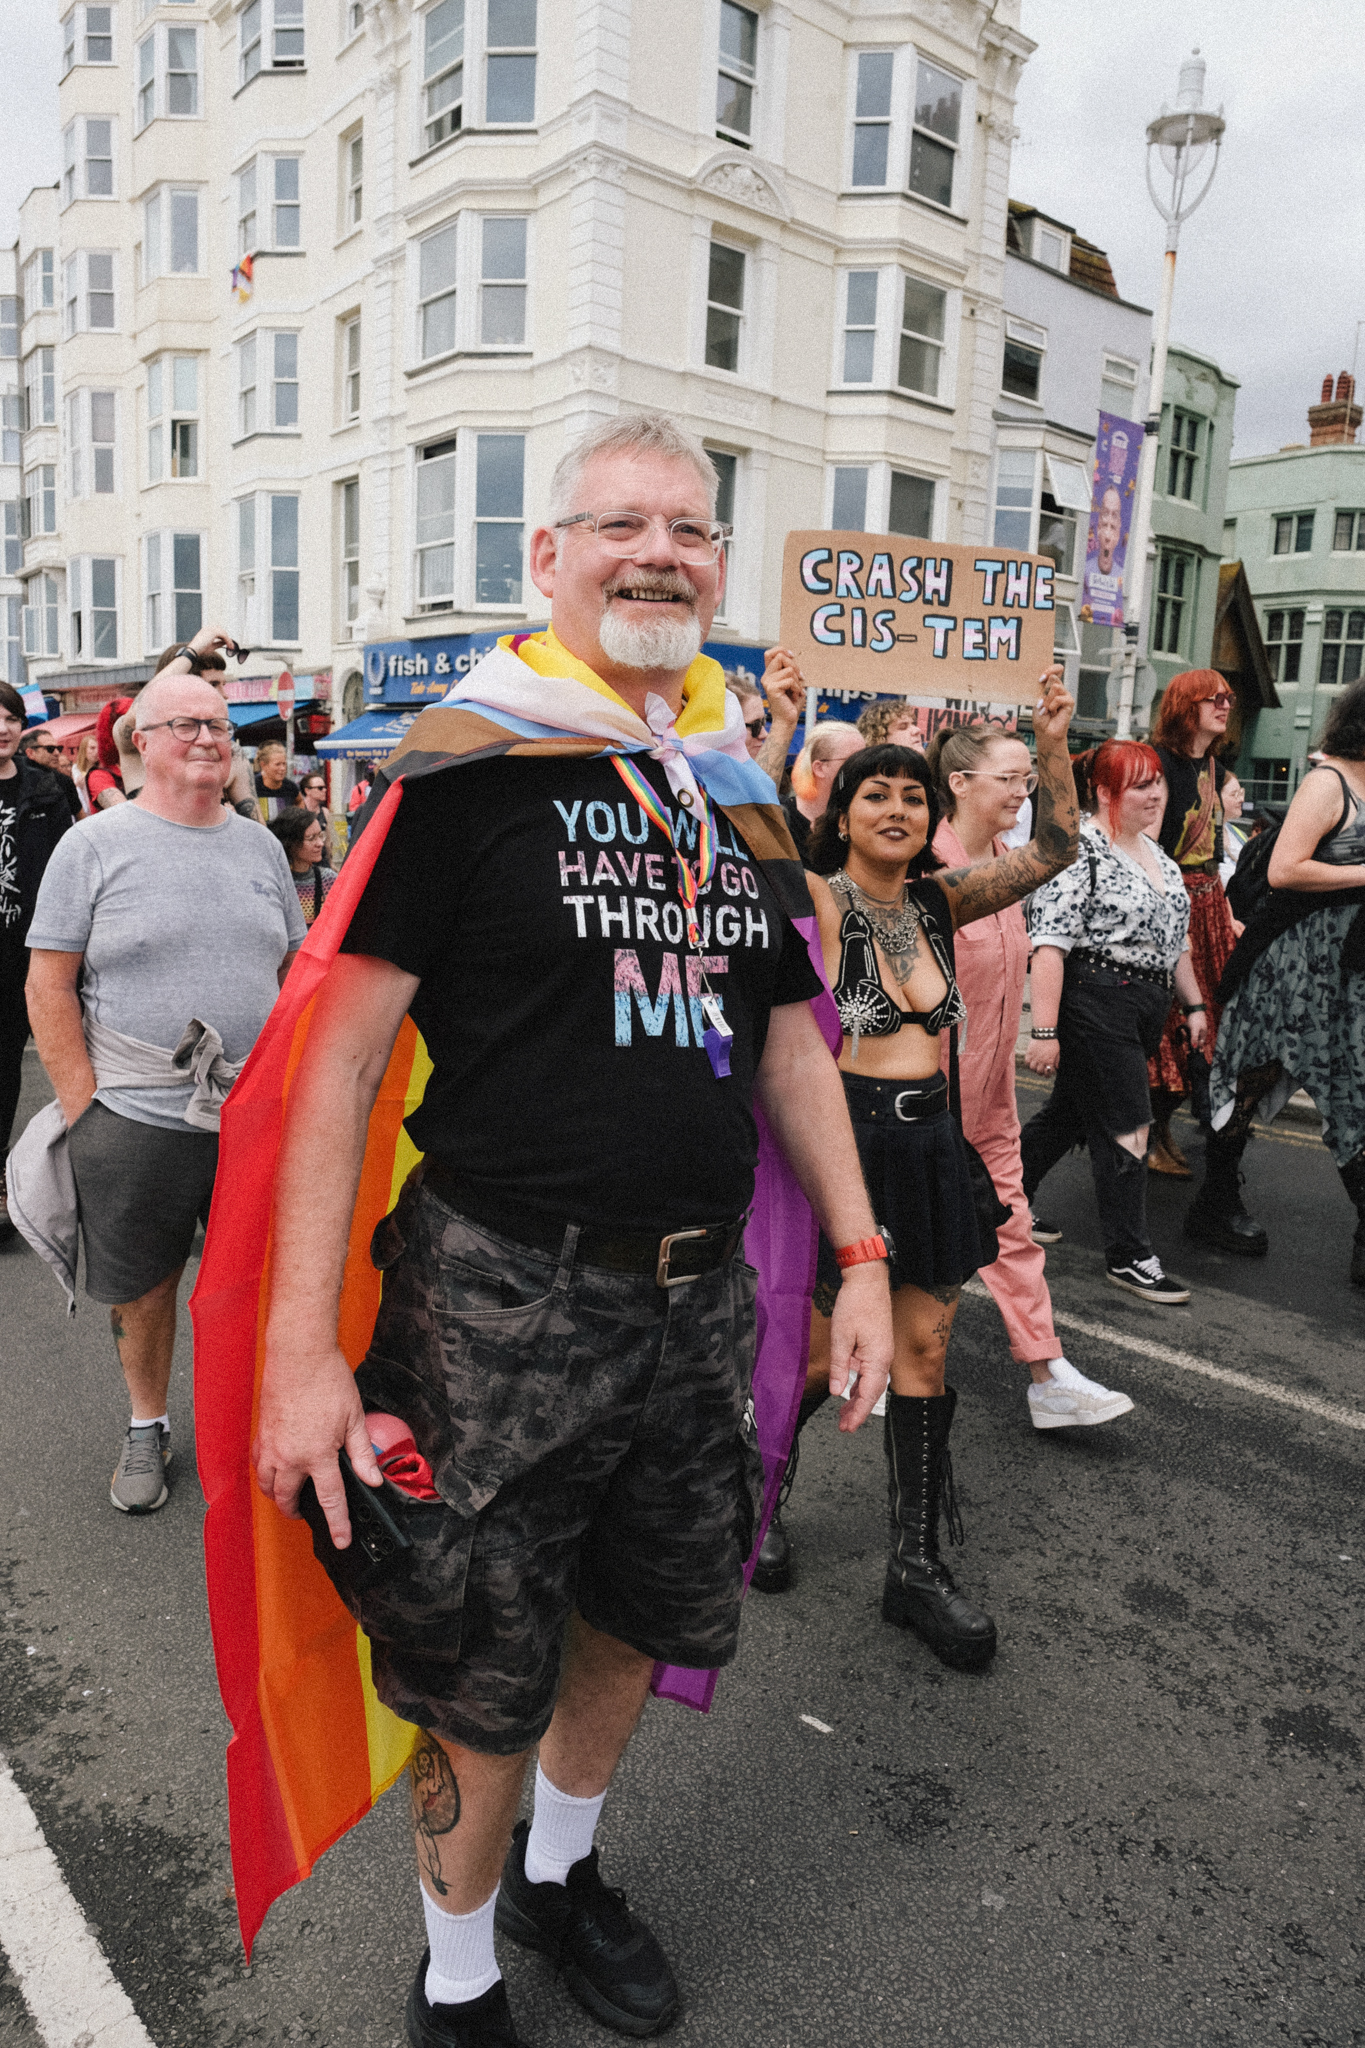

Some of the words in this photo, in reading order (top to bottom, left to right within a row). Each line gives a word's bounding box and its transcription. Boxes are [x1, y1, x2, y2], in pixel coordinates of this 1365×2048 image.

[799, 548, 953, 607] CRASH
[974, 559, 1055, 610] THE
[810, 602, 1022, 661] CIS-TEM
[388, 653, 429, 677] fish
[435, 652, 451, 675] &
[553, 800, 649, 845] YOU
[665, 806, 749, 862] WLL
[558, 851, 666, 891] HAVE
[720, 862, 759, 899] GO
[614, 948, 729, 1048] ME
